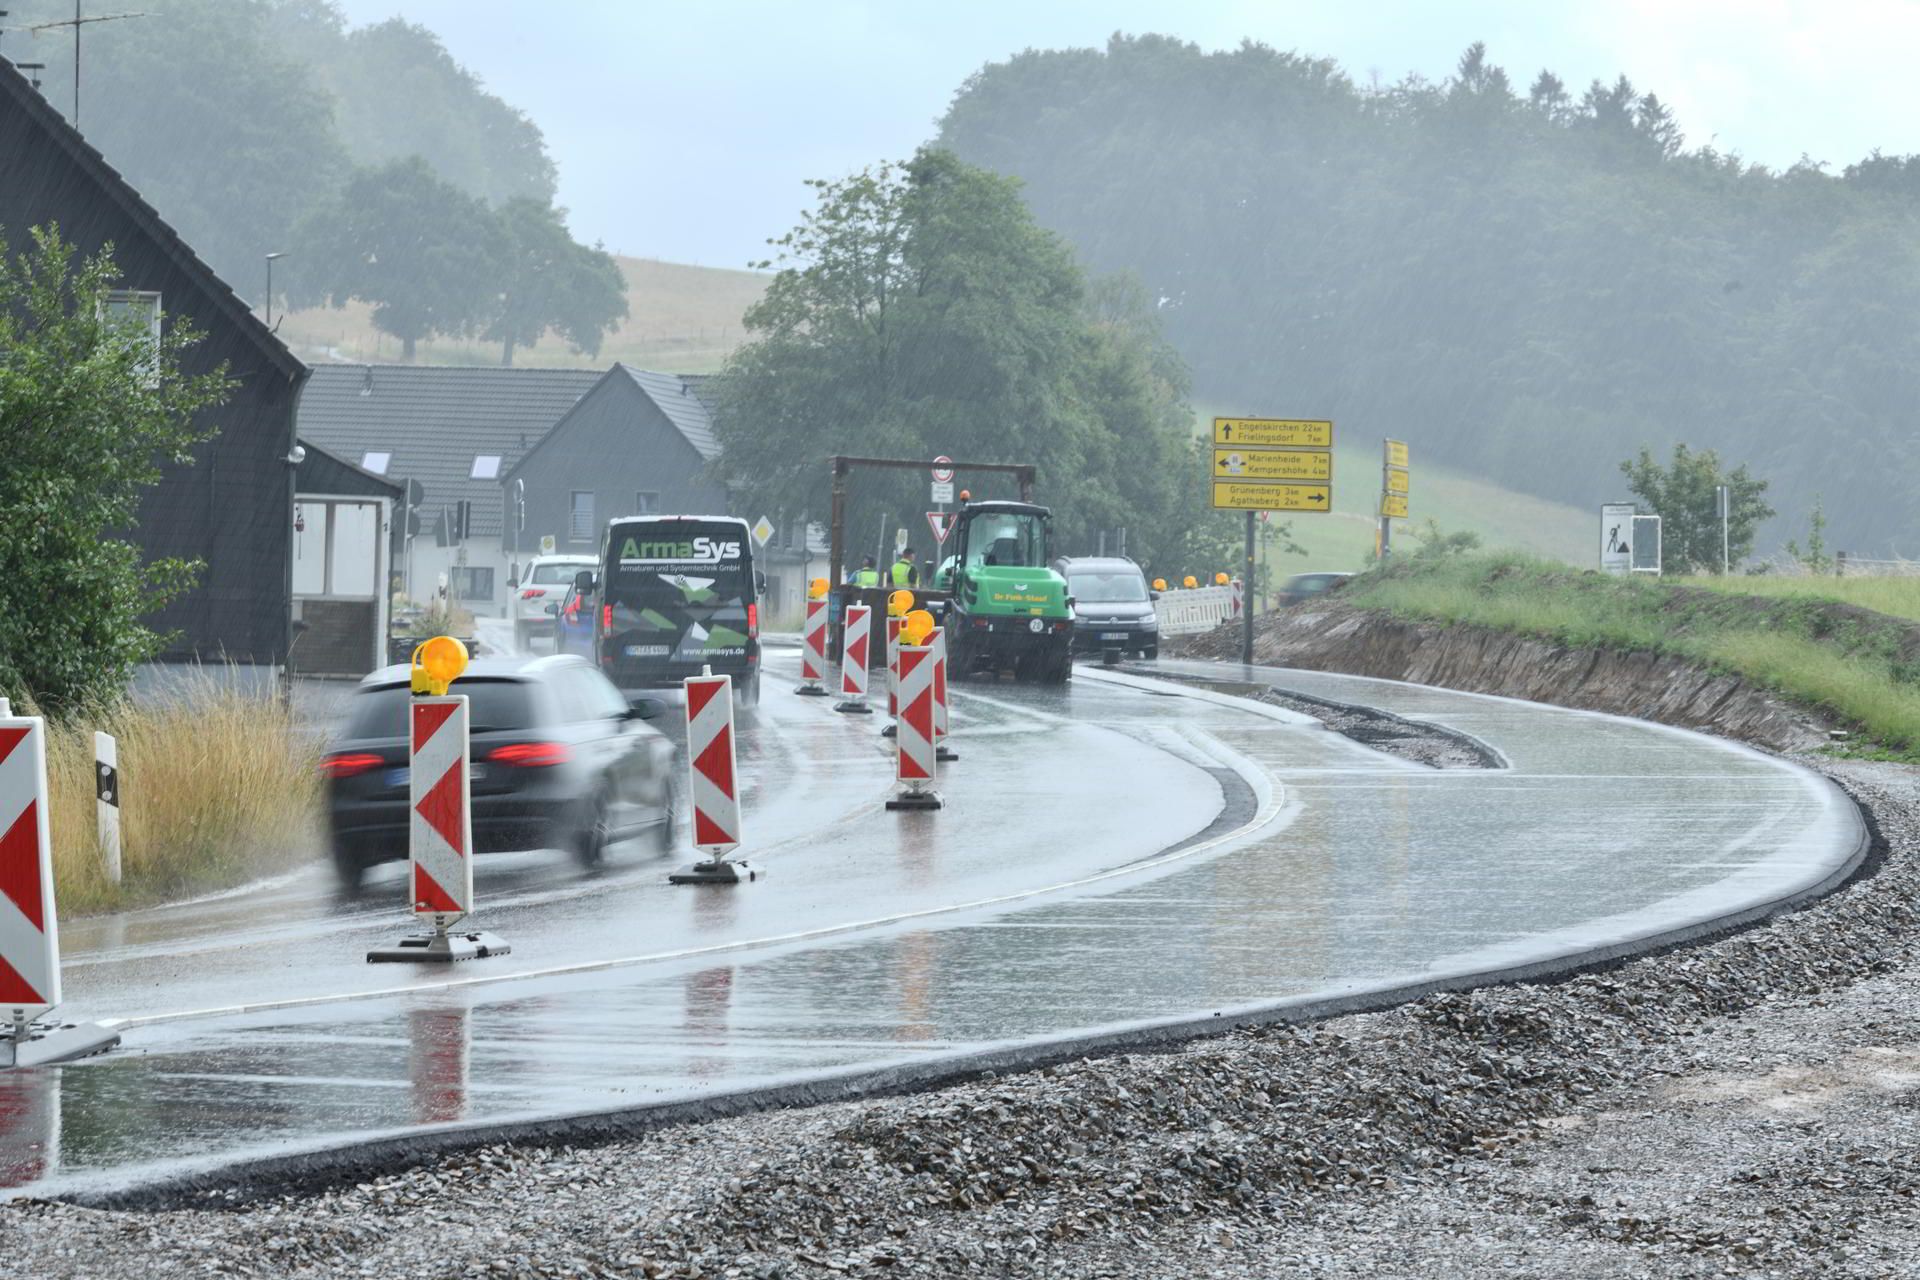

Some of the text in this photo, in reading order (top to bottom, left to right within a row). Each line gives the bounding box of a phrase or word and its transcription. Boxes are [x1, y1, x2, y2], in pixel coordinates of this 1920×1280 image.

[1238, 422, 1299, 433] Engelskirchen
[1238, 432, 1294, 443] Frielingsdorf
[1248, 454, 1302, 464] Marienheide
[1229, 496, 1280, 506] Agathaberg
[619, 537, 740, 564] ArmaSys
[620, 564, 740, 573] Armaturen und Systemtechnik GmbH
[1032, 621, 1041, 630] 20
[682, 647, 745, 657] www.armasys.de
